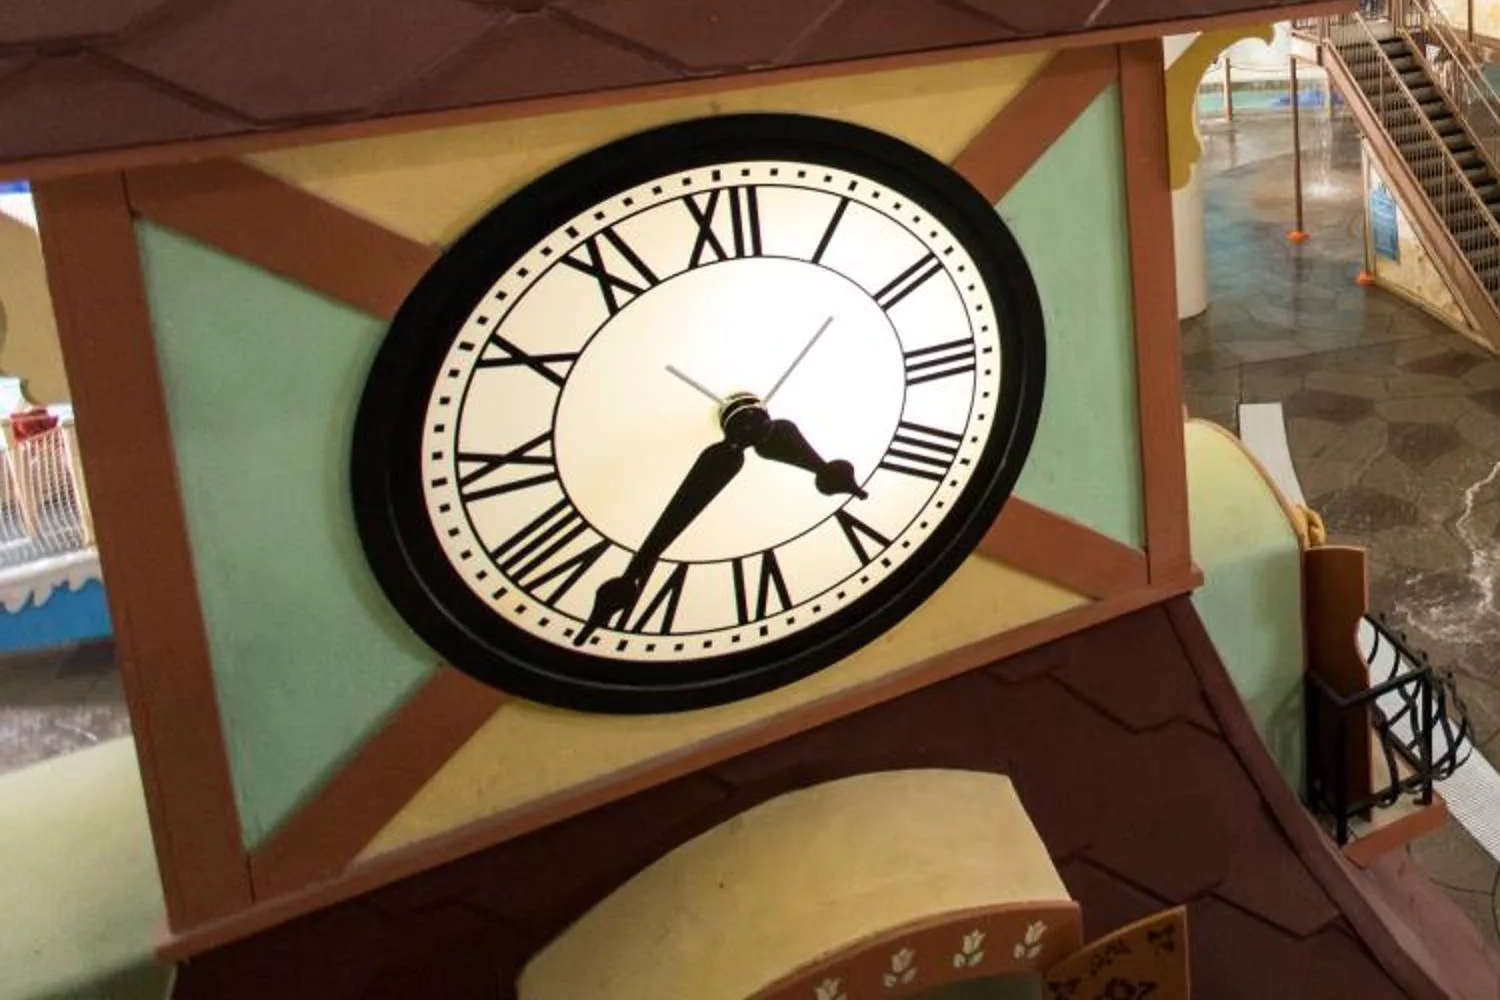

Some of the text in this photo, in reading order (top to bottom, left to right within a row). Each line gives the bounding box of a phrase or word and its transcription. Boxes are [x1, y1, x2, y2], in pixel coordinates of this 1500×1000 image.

[682, 184, 763, 270] XII
[563, 227, 661, 316] XI
[474, 332, 581, 388] X
[903, 337, 977, 387] III
[834, 509, 895, 568] V
[731, 548, 794, 624] VI
